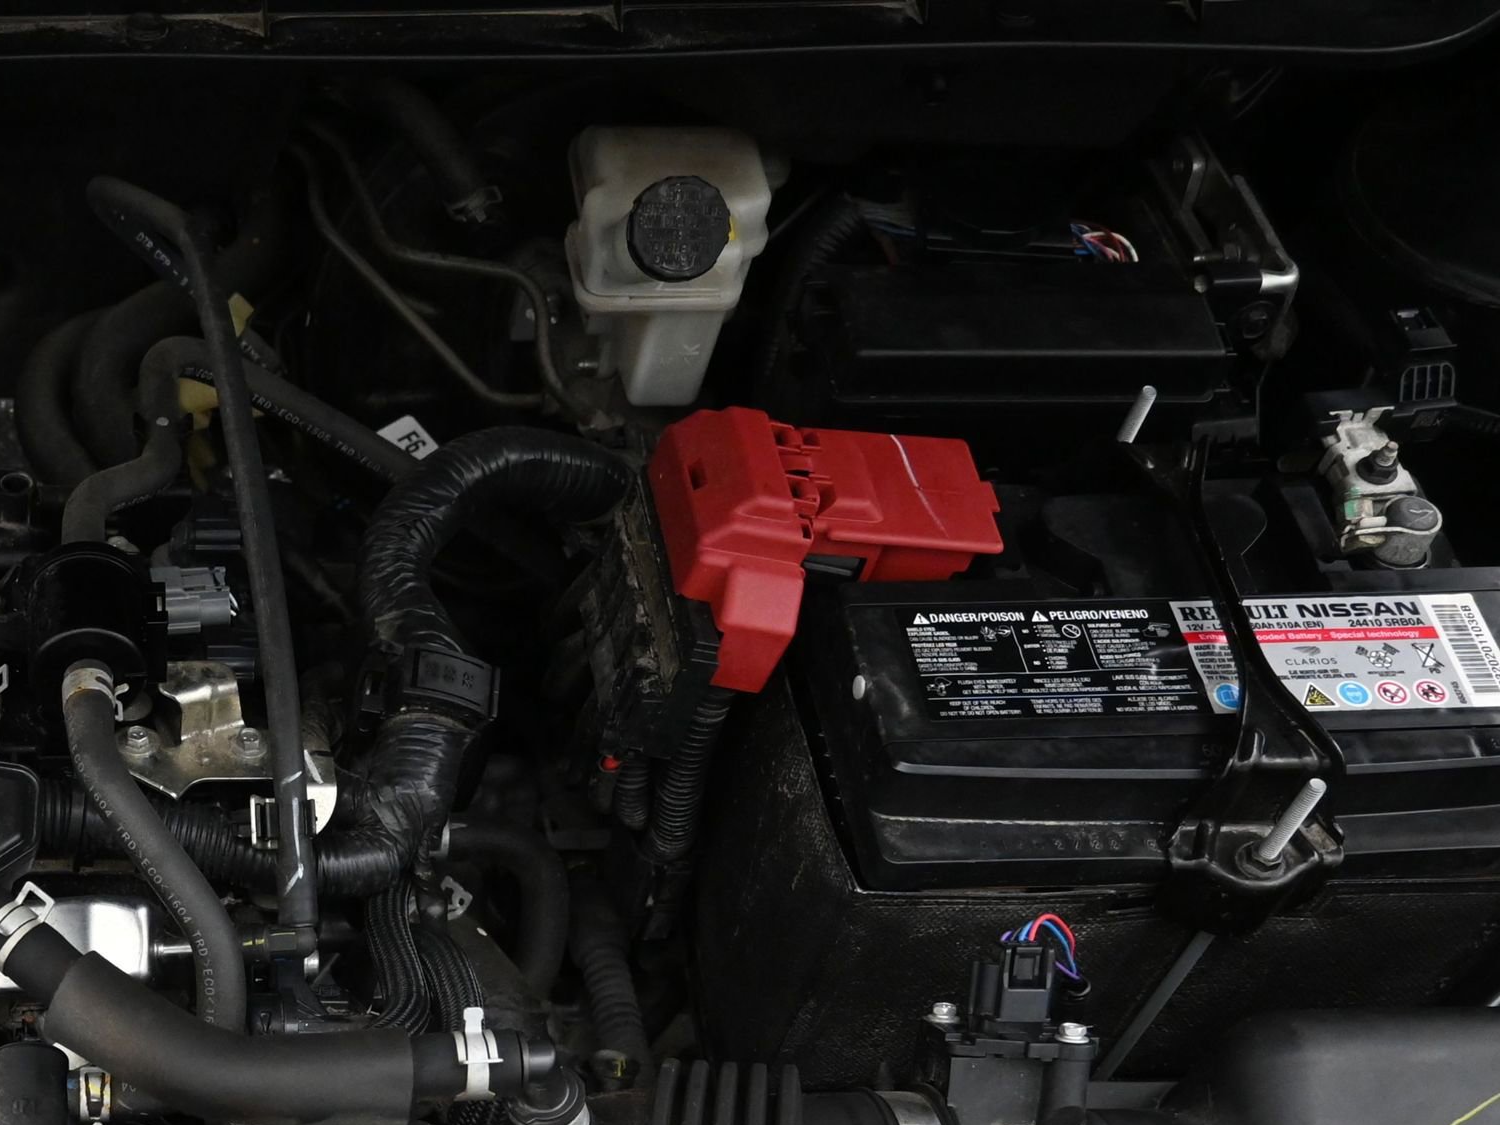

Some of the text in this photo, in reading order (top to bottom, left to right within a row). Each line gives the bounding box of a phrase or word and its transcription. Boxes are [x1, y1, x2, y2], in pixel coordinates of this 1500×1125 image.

[397, 430, 426, 454] F6
[928, 611, 1026, 623] DANGER/POISON
[1049, 608, 1150, 621] PELIGRO/VENENO
[1177, 601, 1421, 621] REULT NISSAN
[1277, 620, 1301, 629] 510A
[1302, 618, 1324, 629] (EN)
[1348, 618, 1382, 628] 24410
[1288, 631, 1322, 641] Battery
[1330, 630, 1365, 640] Special
[1366, 629, 1419, 639] technology
[1285, 657, 1338, 666] CLARIOS
